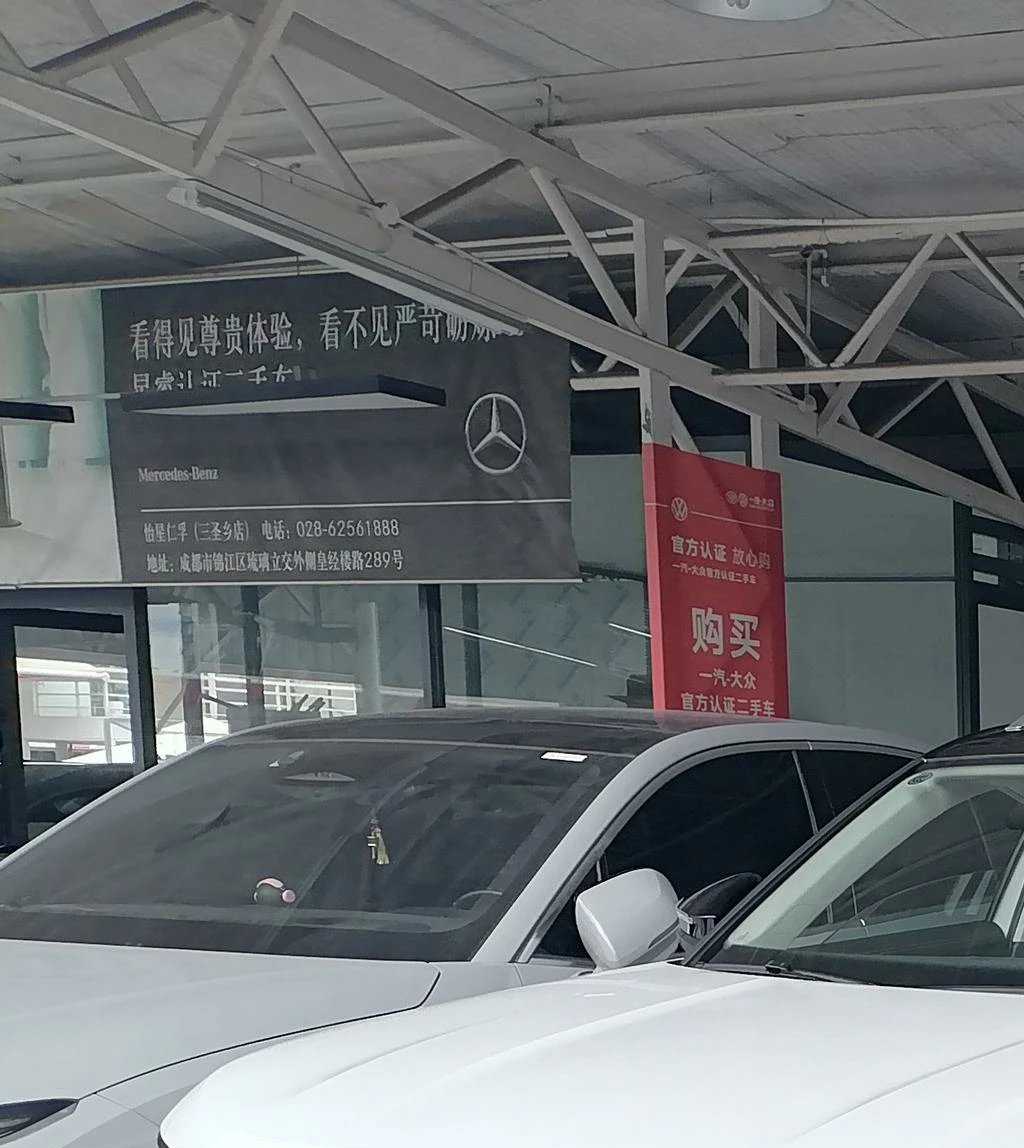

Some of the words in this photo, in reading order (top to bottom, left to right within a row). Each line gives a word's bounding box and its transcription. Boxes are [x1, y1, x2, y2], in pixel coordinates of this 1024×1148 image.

[138, 466, 219, 483] Mercedes-Benz
[671, 535, 727, 562] 官方认证
[732, 547, 771, 570] 放心购
[671, 563, 757, 585] 一汽-大众官方认证二手车
[691, 607, 761, 661] 购买
[698, 668, 757, 690] 一汽-大众
[680, 692, 776, 717] 官方认证二手车
